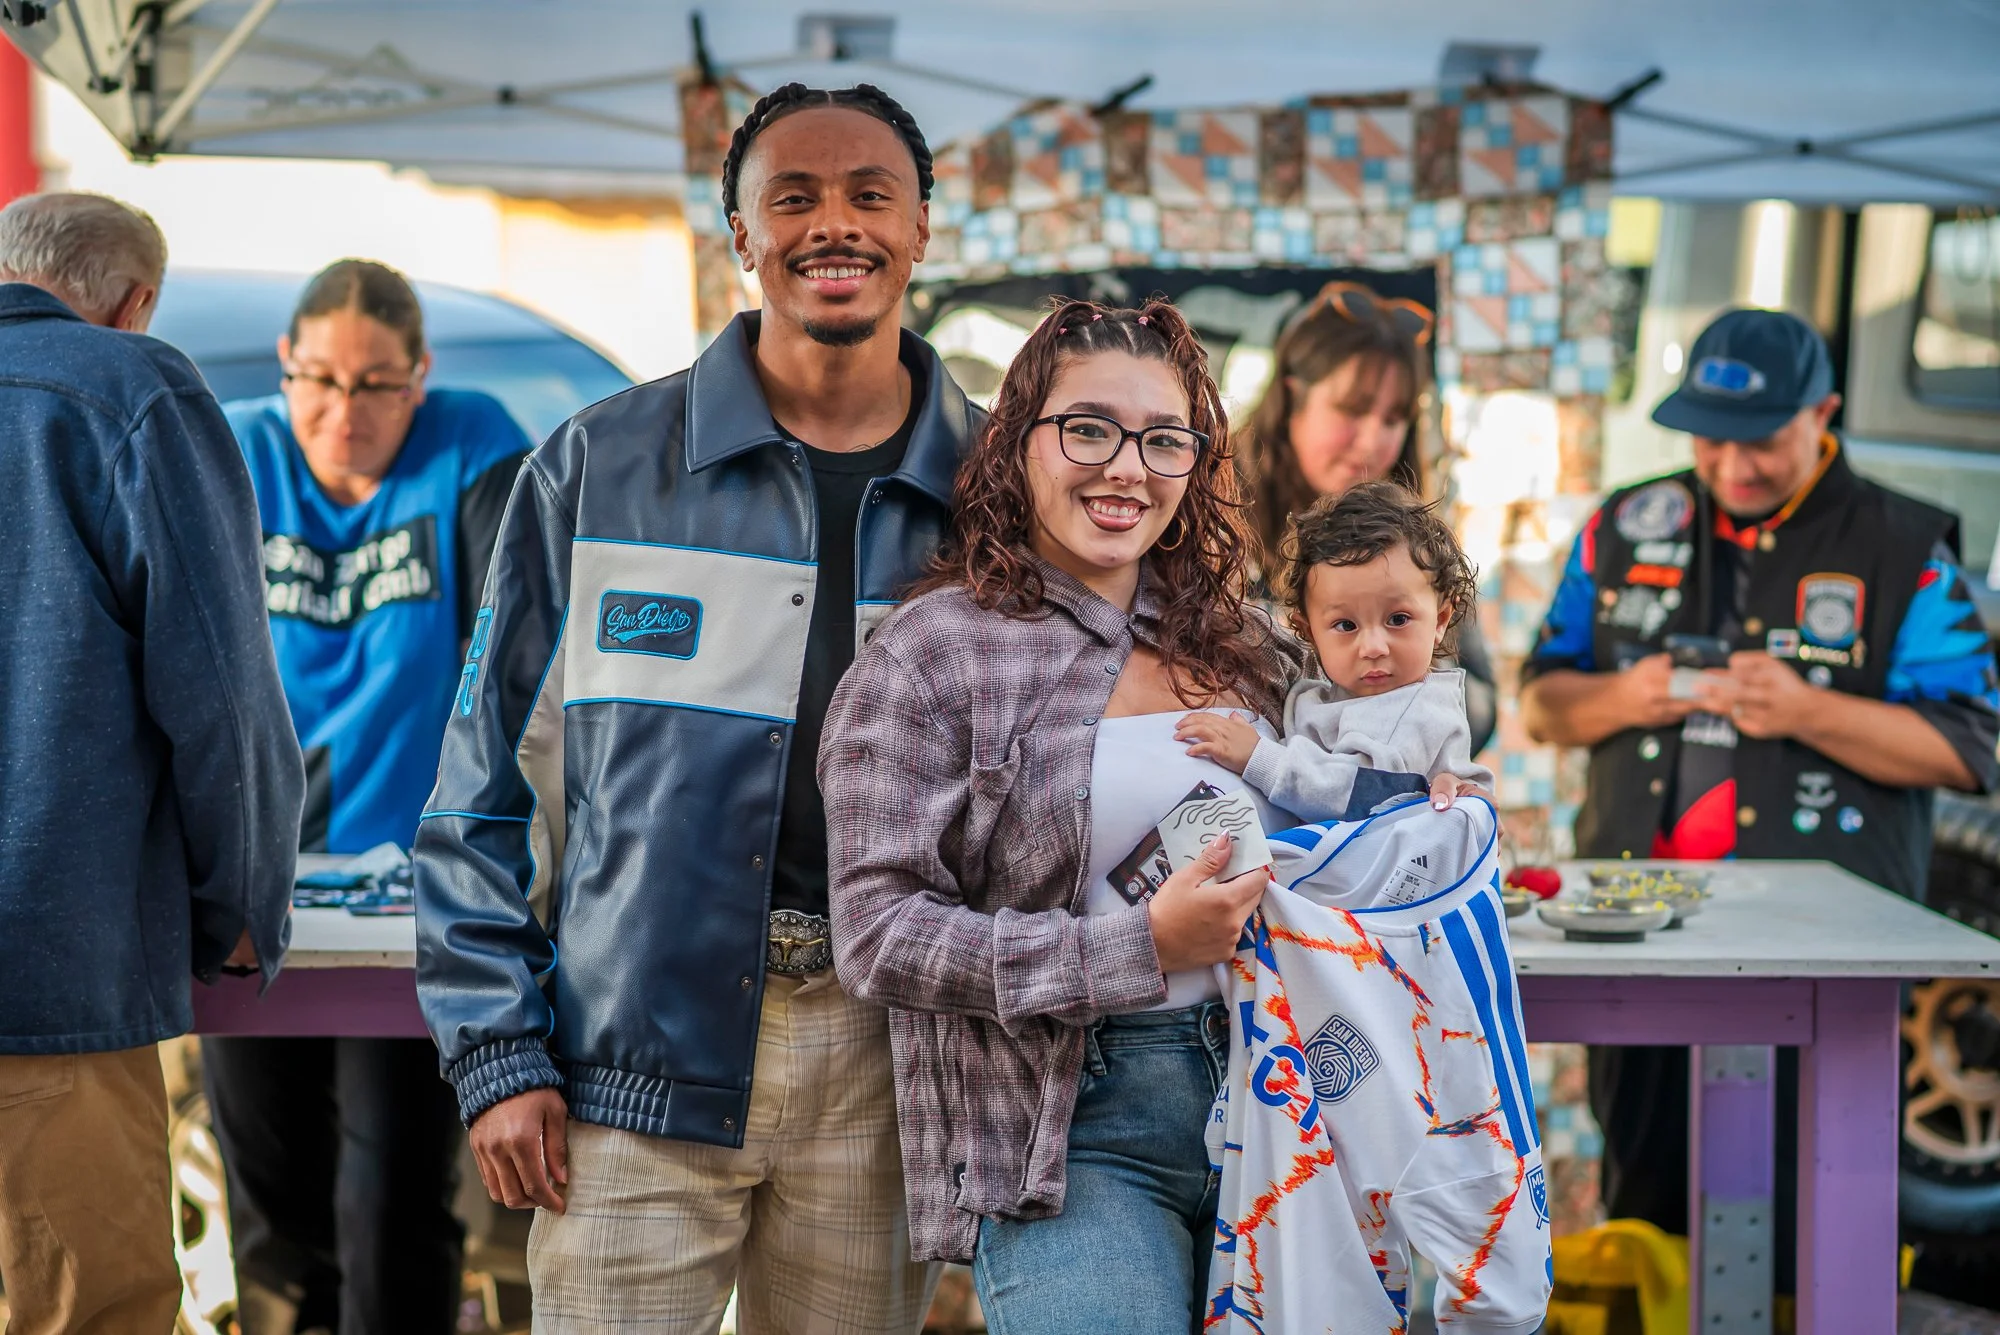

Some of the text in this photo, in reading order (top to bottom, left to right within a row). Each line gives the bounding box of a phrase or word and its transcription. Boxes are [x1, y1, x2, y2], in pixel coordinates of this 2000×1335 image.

[607, 602, 691, 635] San Diego
[1328, 1021, 1374, 1070] SAN DIEGO
[1321, 1062, 1334, 1076] FC
[1531, 1172, 1545, 1189] ML
